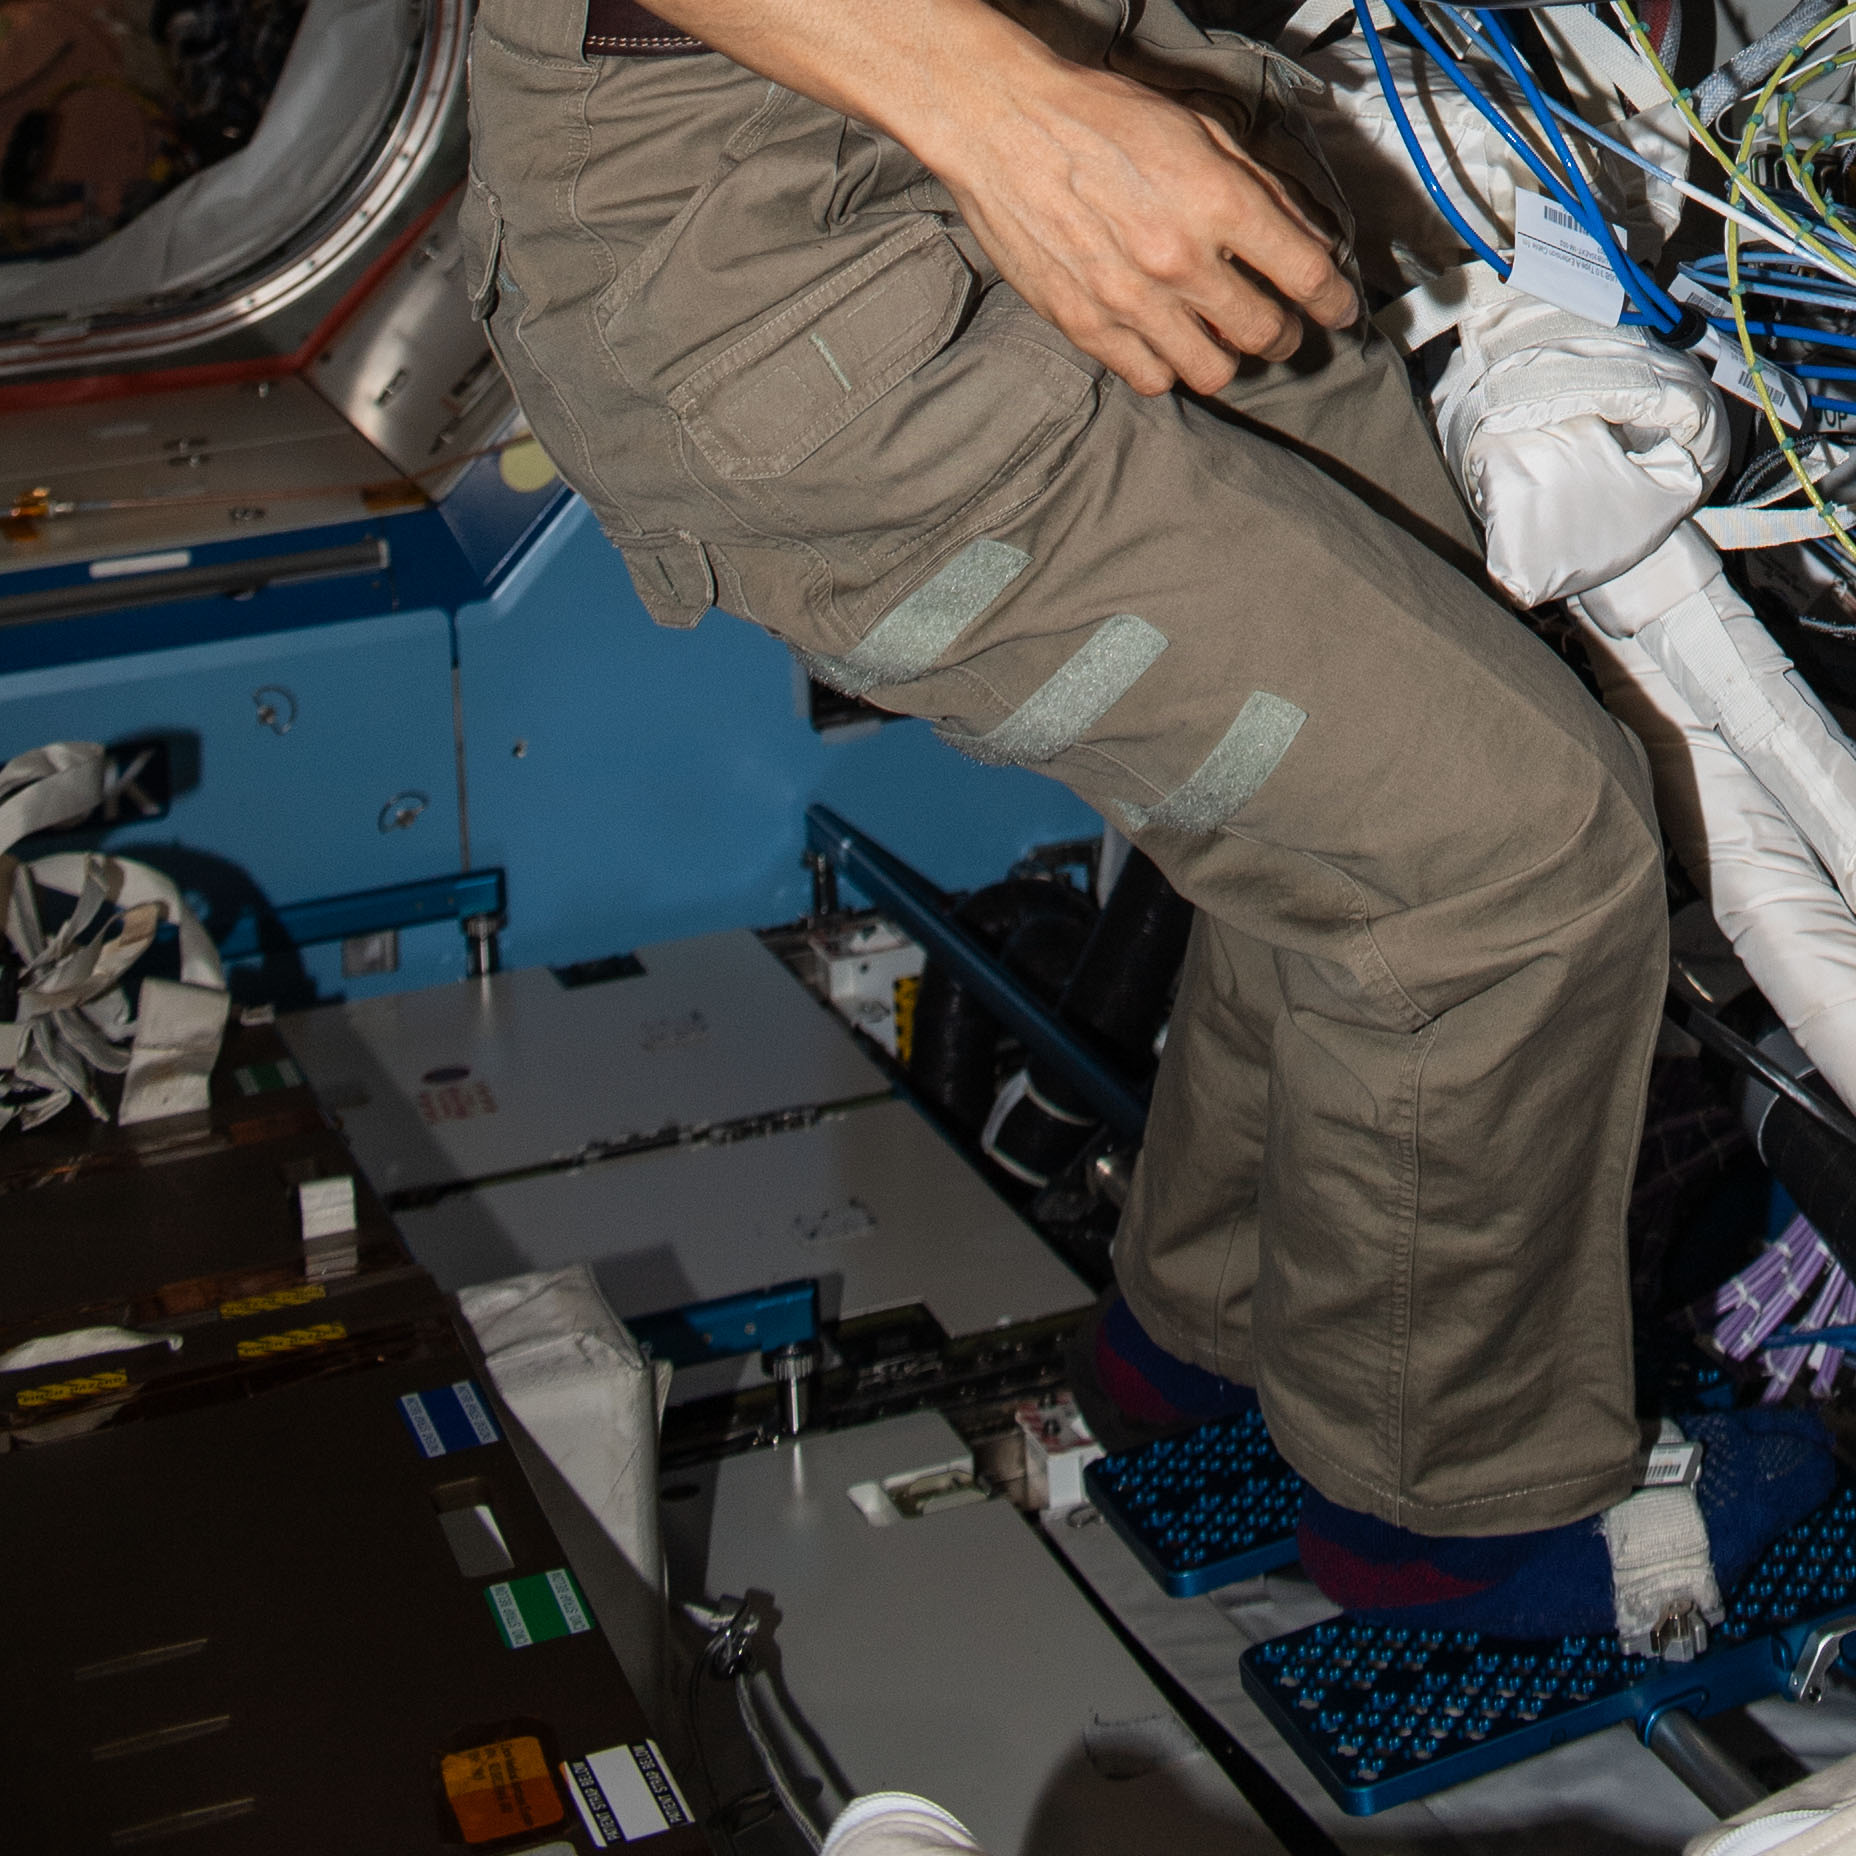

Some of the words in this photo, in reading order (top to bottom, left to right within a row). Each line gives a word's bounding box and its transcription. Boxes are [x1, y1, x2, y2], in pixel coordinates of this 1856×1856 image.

[634, 1742, 660, 1769] BELOW
[570, 1760, 595, 1787] BELOW
[647, 1769, 670, 1793] STRAP
[582, 1787, 605, 1811] STRAP
[658, 1793, 684, 1824] PATIENT
[592, 1811, 619, 1841] PATIENT
